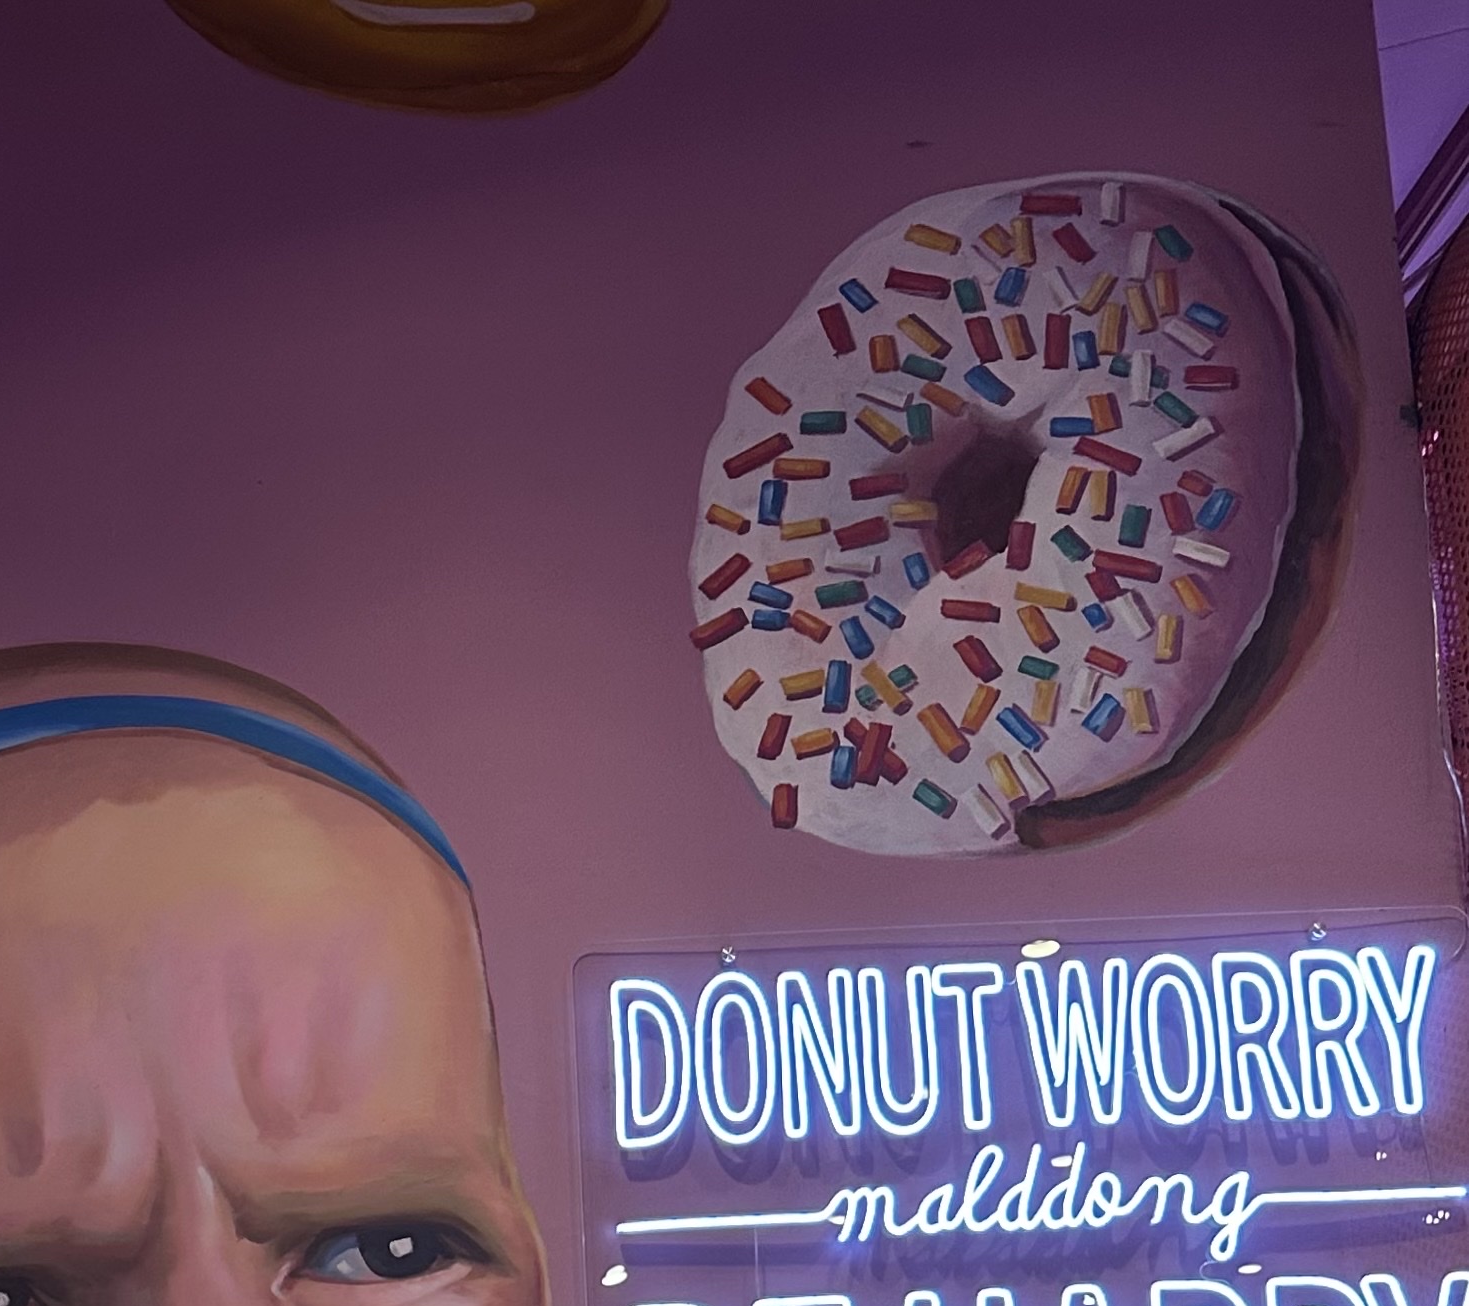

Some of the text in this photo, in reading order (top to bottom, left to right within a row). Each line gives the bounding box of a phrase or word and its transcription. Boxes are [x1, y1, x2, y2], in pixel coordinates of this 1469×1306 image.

[609, 944, 1436, 1149] DONUT WORRY
[827, 1141, 1251, 1262] malddong
